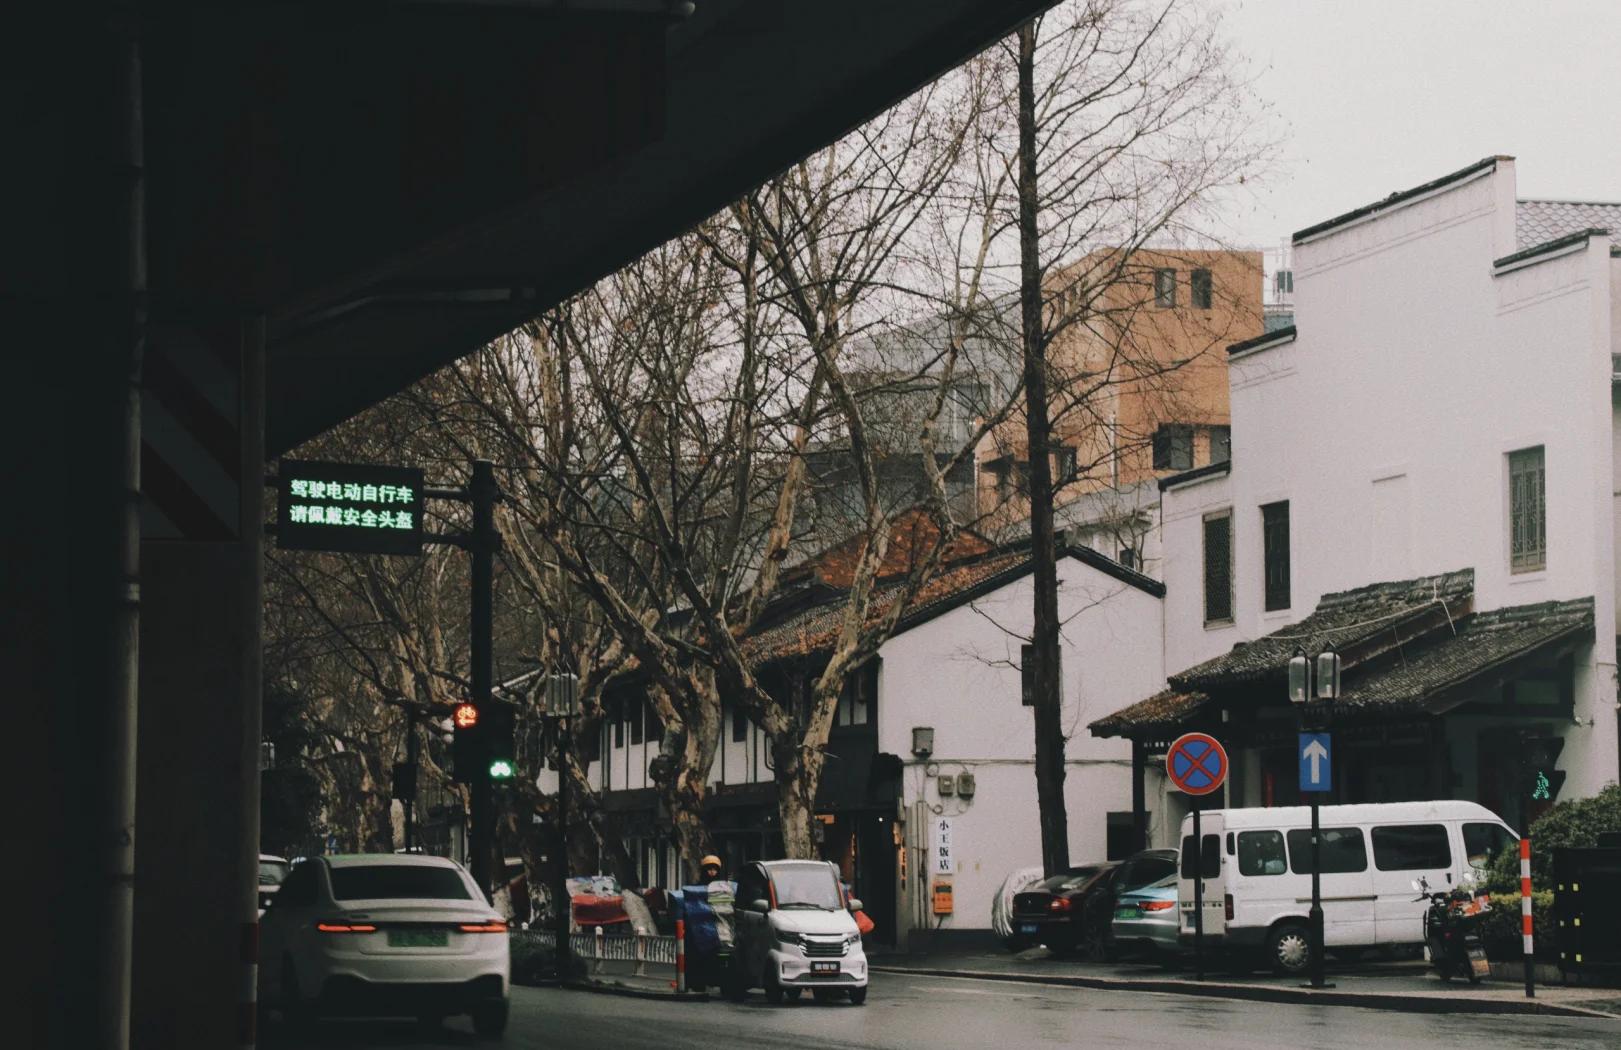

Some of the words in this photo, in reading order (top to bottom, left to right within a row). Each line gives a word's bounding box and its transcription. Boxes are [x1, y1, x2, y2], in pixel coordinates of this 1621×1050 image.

[290, 479, 413, 503] 驾驶电动自行车
[290, 505, 413, 529] 请佩戴安全头盔
[939, 820, 950, 870] 小王饭店
